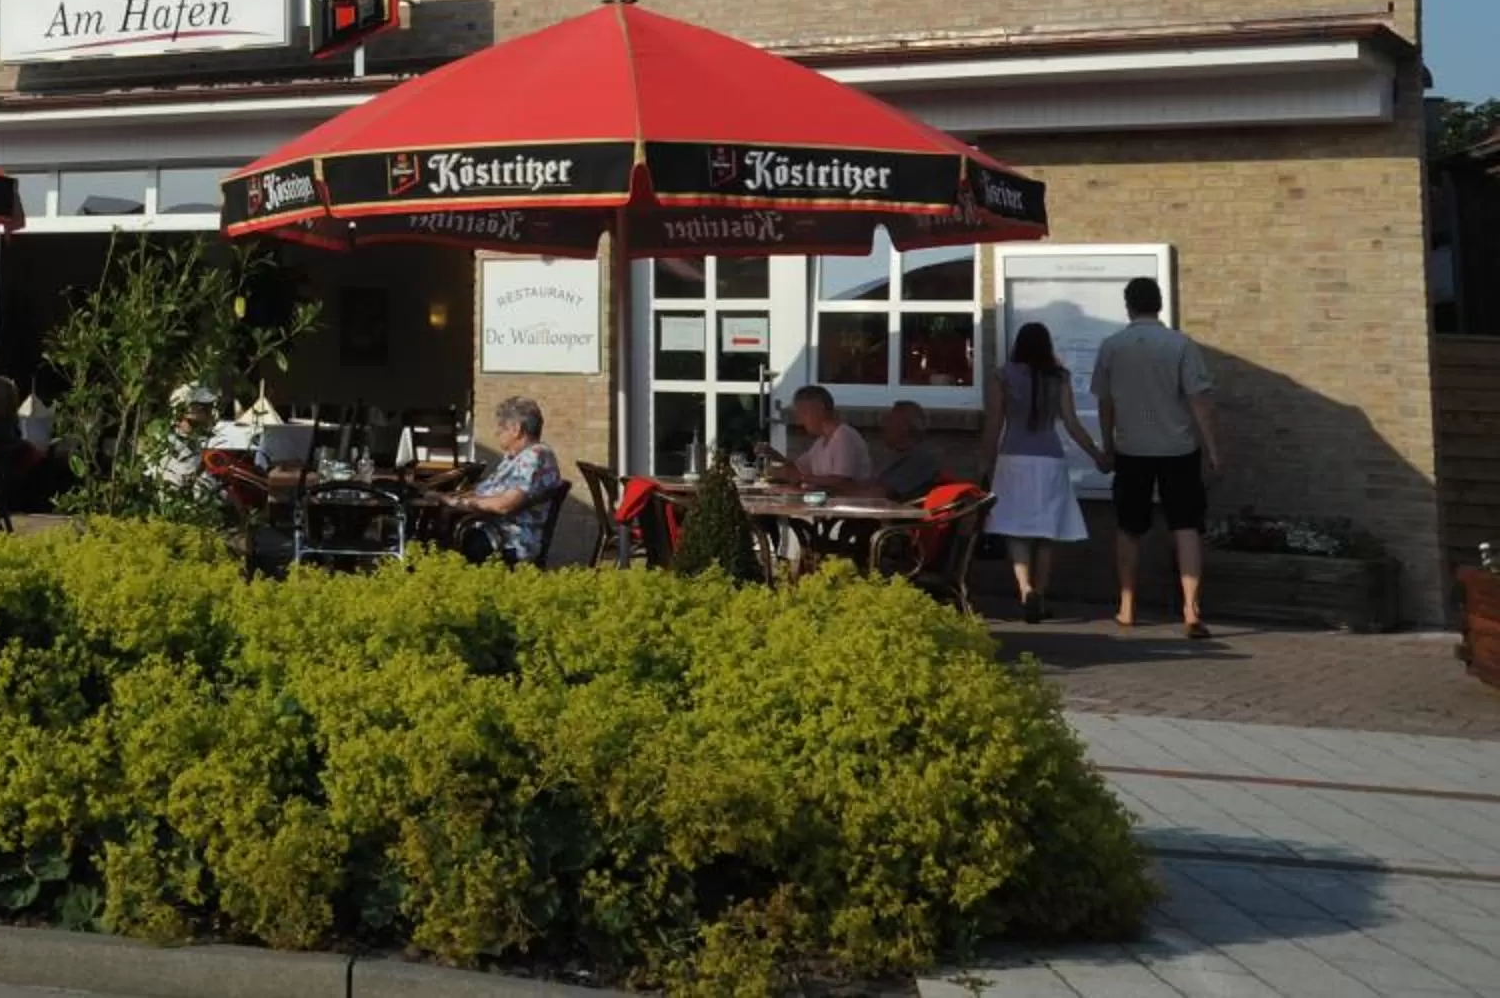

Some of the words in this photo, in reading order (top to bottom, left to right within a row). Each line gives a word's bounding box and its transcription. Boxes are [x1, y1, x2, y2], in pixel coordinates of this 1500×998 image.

[43, 1, 105, 38] Am
[427, 152, 575, 194] Köstritzer
[744, 151, 892, 195] Köstritzer
[496, 285, 584, 308] RESTAURANT
[485, 327, 505, 345] De
